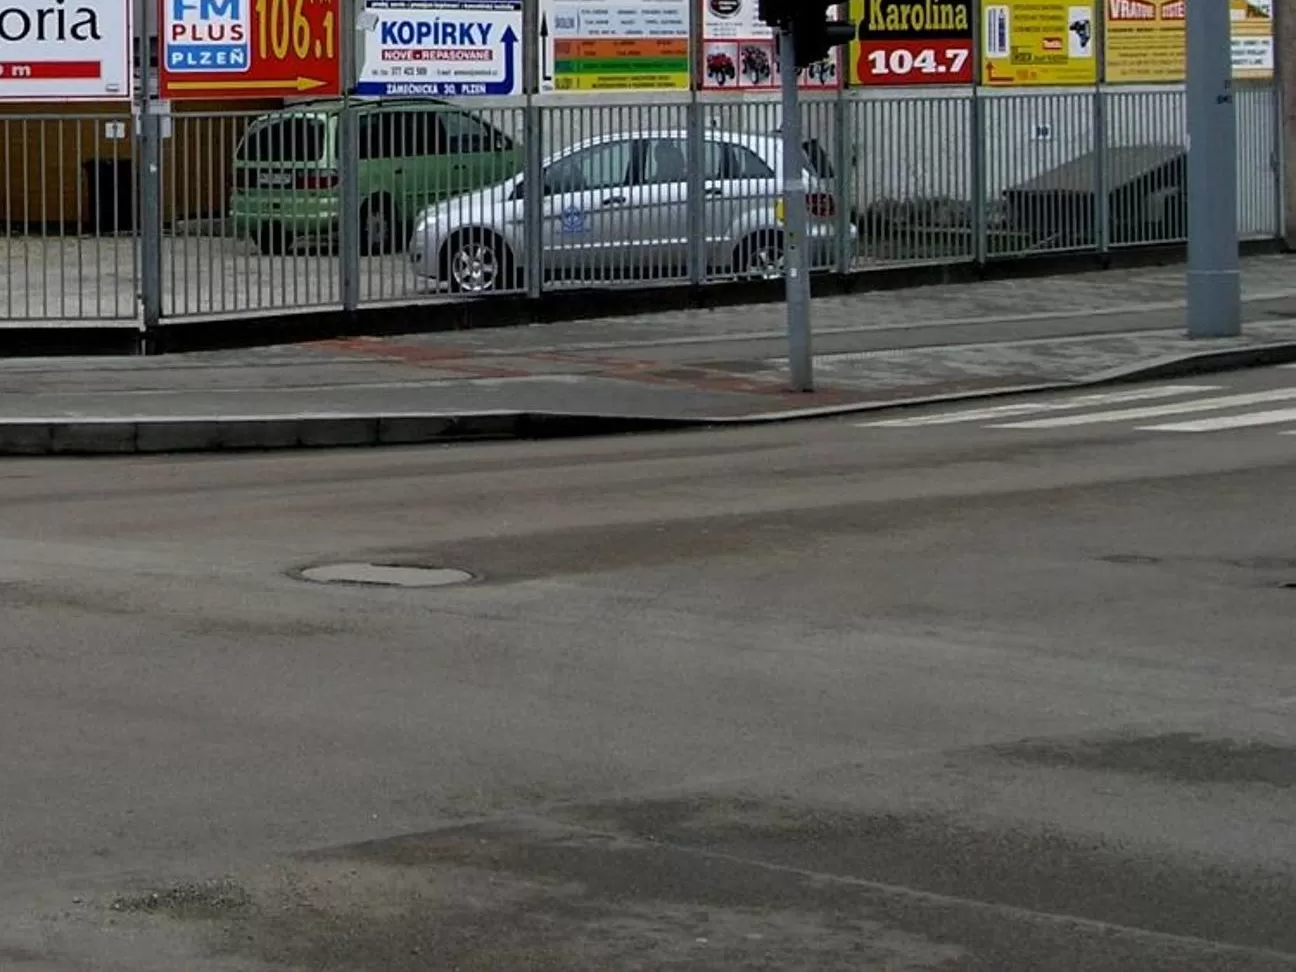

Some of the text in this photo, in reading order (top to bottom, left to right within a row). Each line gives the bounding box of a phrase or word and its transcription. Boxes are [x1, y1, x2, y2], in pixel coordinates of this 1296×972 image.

[172, 24, 244, 41] PLUS
[381, 17, 493, 45] KOPÍRKY
[172, 48, 245, 65] PLZEŇ
[867, 49, 969, 74] 104.7
[12, 66, 32, 77] m
